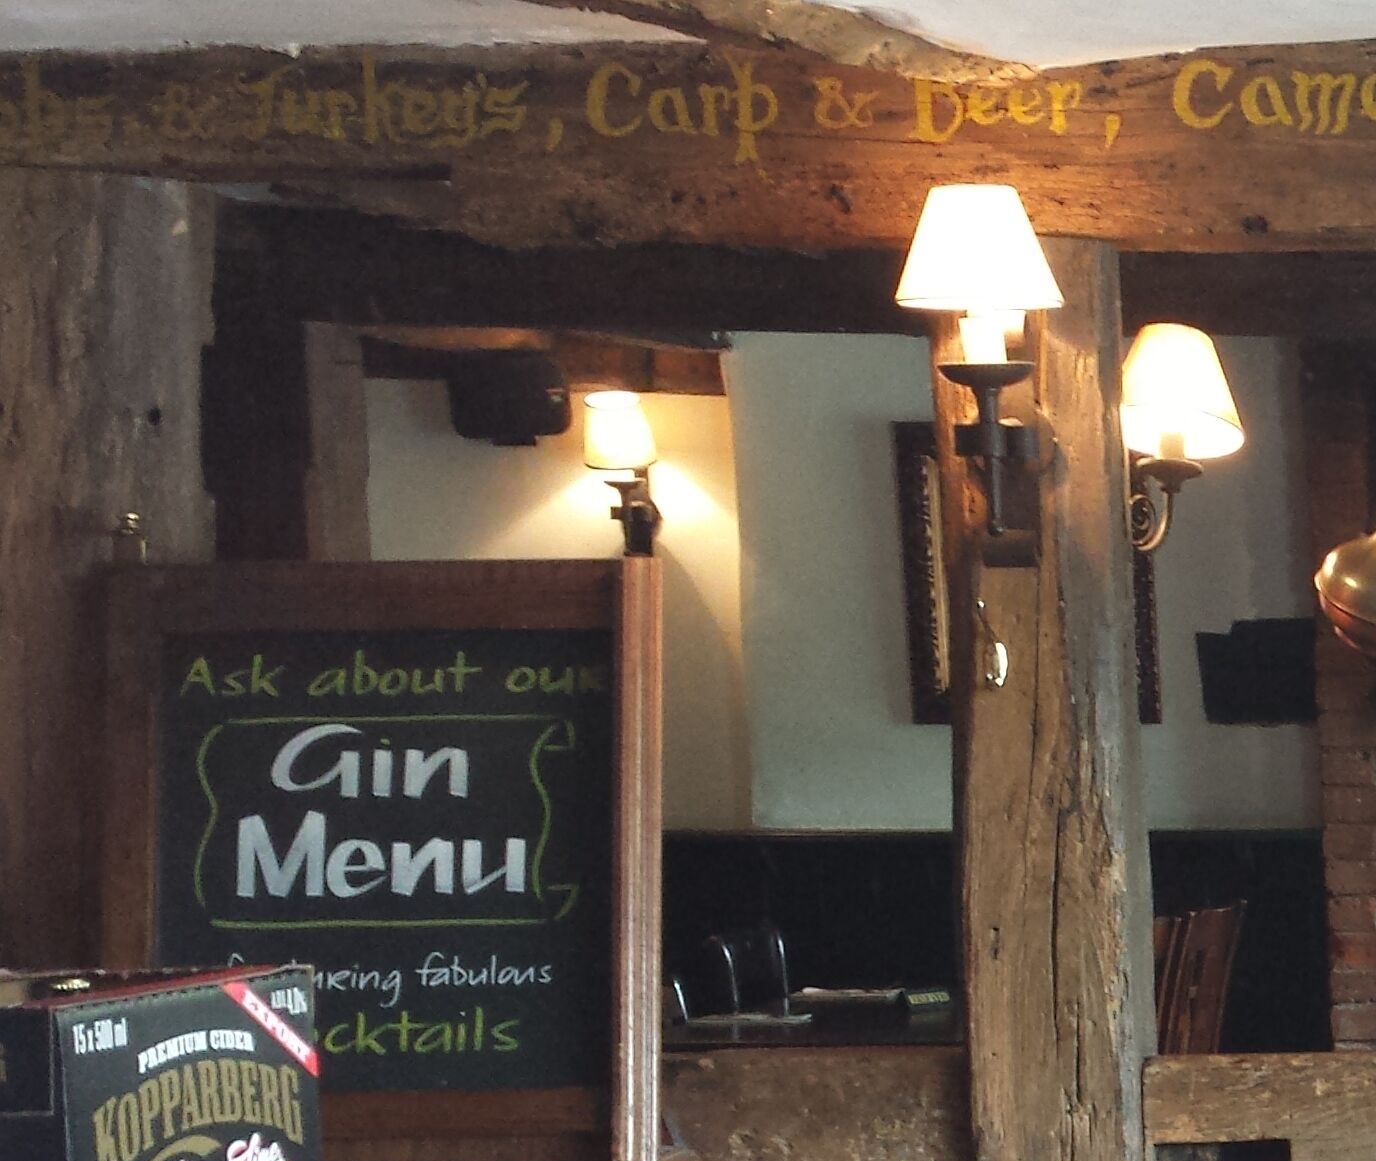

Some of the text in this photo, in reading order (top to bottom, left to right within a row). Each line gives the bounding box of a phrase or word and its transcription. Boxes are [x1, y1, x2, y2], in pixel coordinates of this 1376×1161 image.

[586, 45, 780, 165] Carp
[813, 75, 880, 128] &
[181, 653, 287, 697] Ask
[307, 649, 482, 697] about
[270, 723, 469, 799] Gin
[236, 810, 526, 899] Menu
[415, 951, 554, 989] fabulous
[137, 1029, 255, 1074] PREMIUM CIDER
[313, 1006, 521, 1057] cktails
